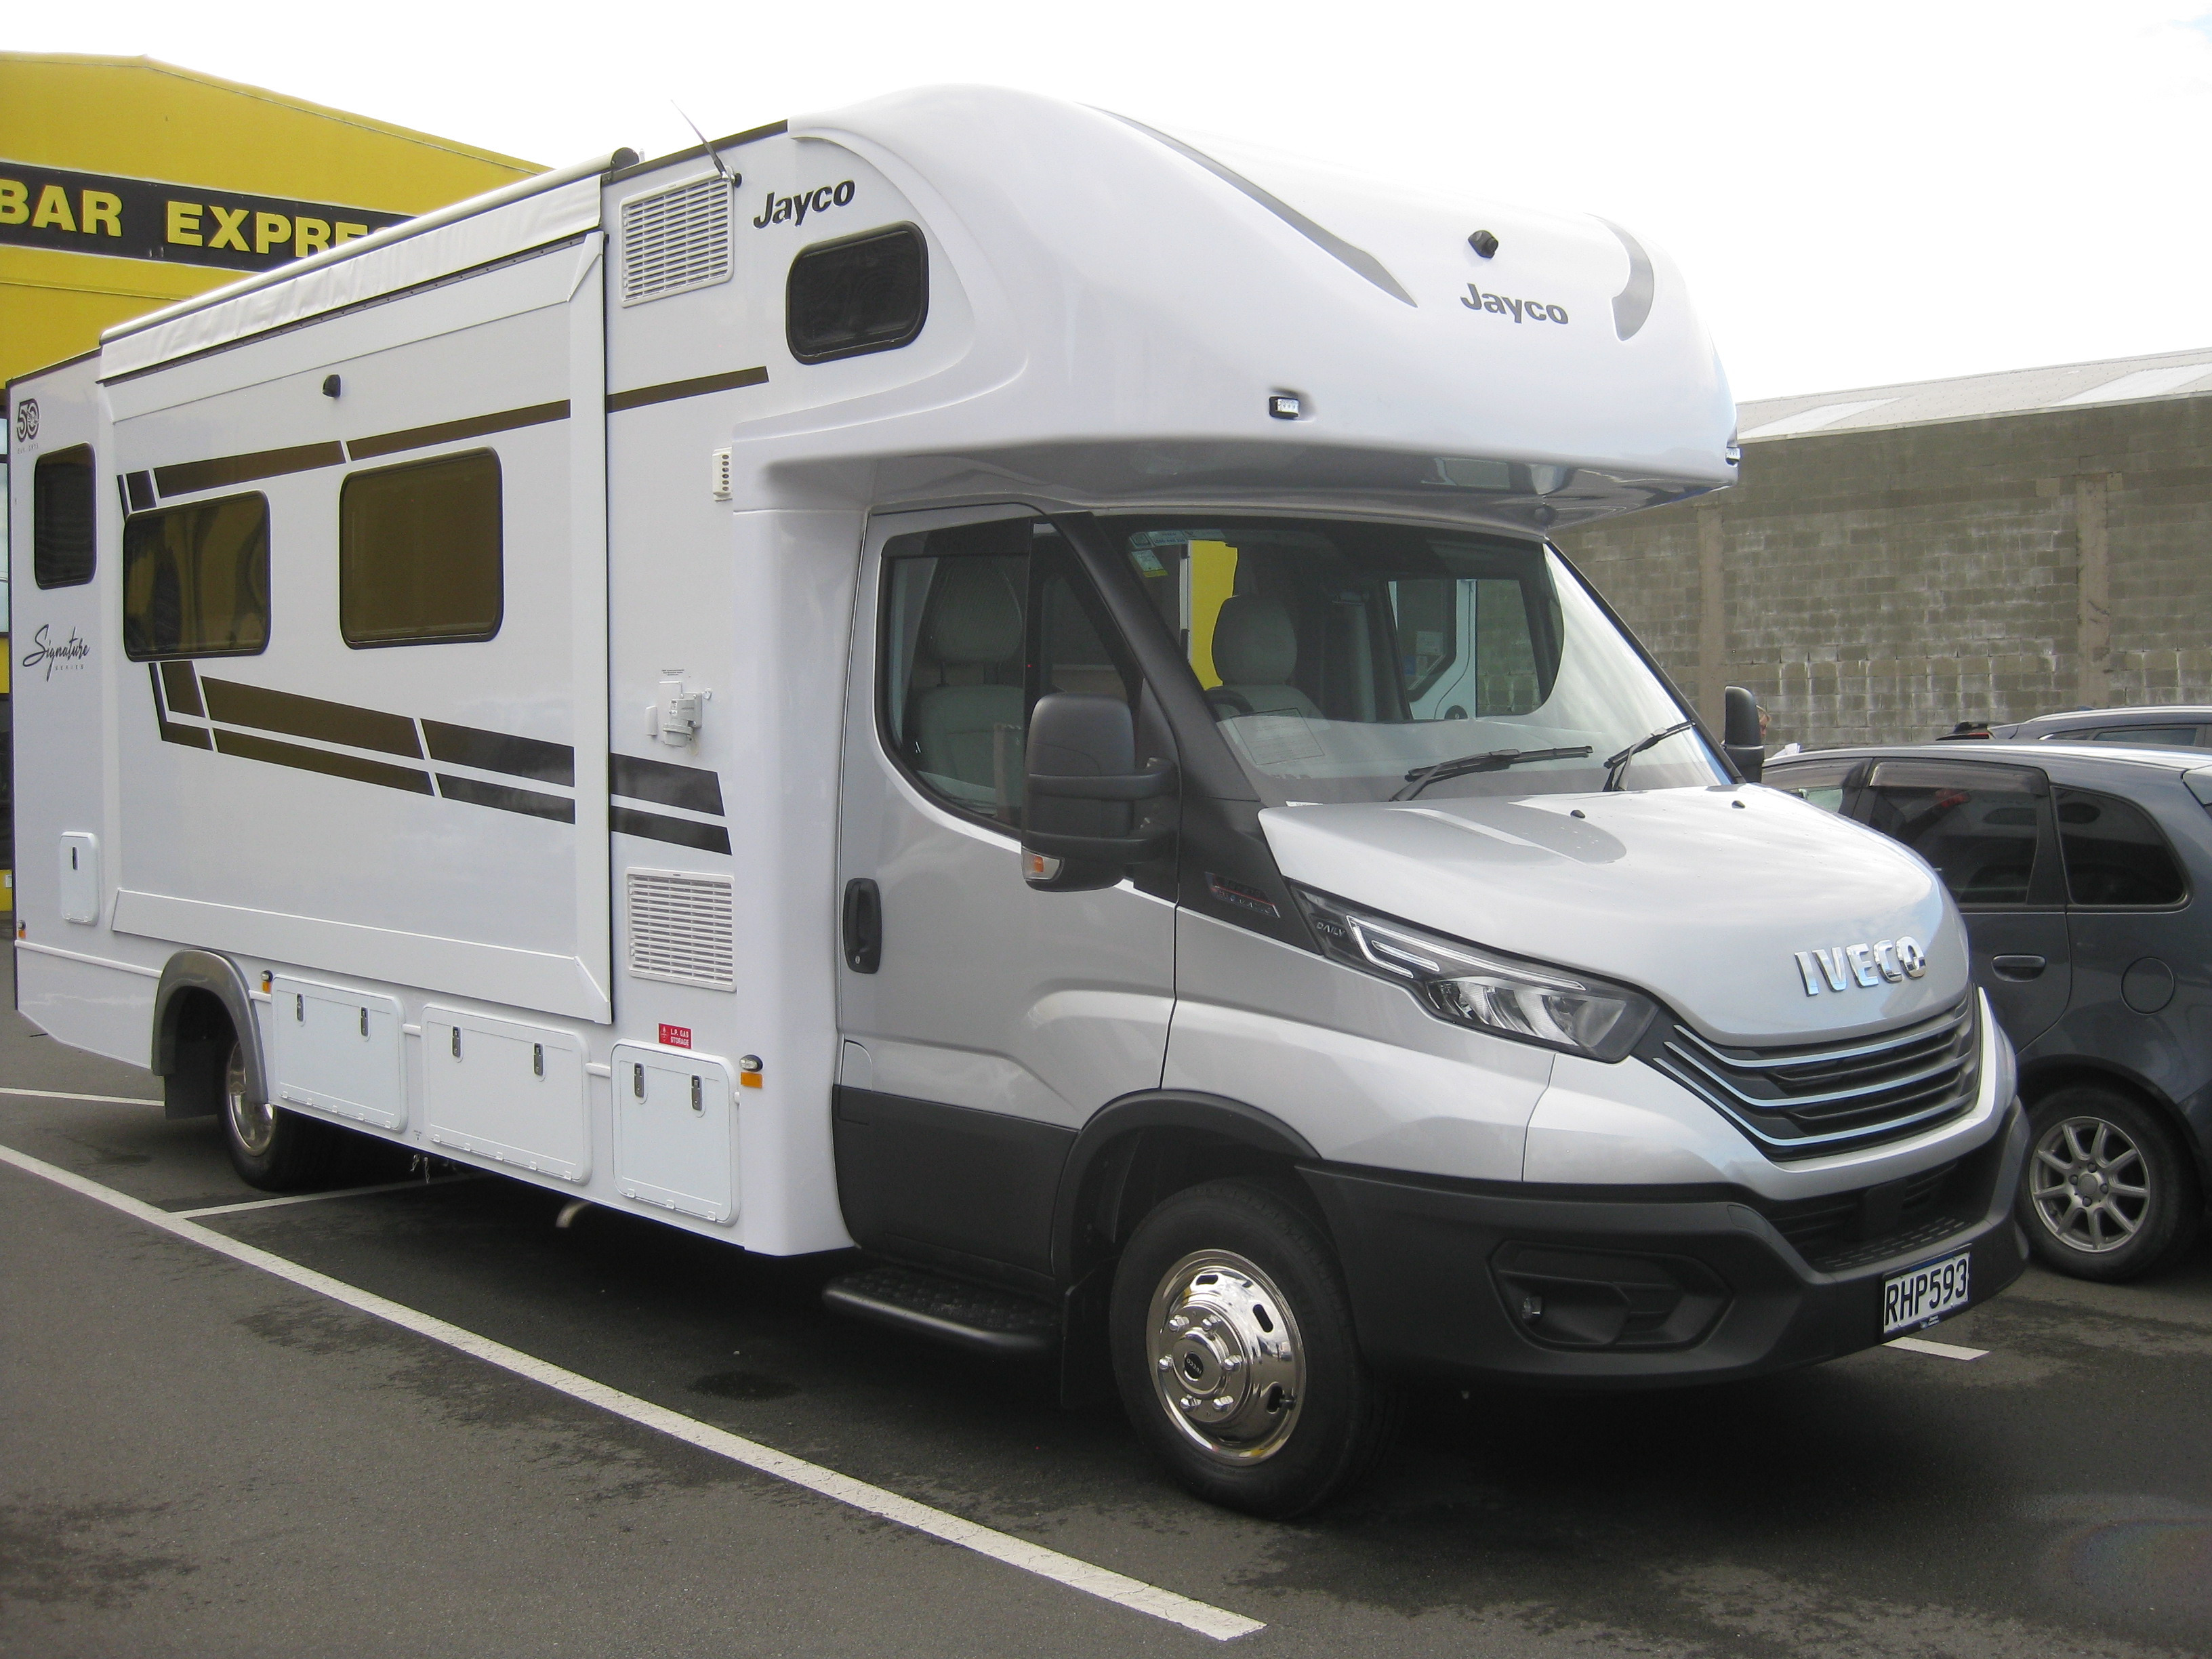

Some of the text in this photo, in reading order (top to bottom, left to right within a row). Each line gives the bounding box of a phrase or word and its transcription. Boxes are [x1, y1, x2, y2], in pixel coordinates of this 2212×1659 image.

[0, 178, 391, 259] BAR EXPR
[753, 180, 855, 229] Jayco
[1460, 282, 1569, 325] Jayco
[22, 623, 91, 682] Signature
[1316, 922, 1346, 937] DAILY
[1794, 936, 1927, 997] IVECO
[1885, 1258, 1967, 1326] RHP593
[1186, 1357, 1203, 1374] IVECO
